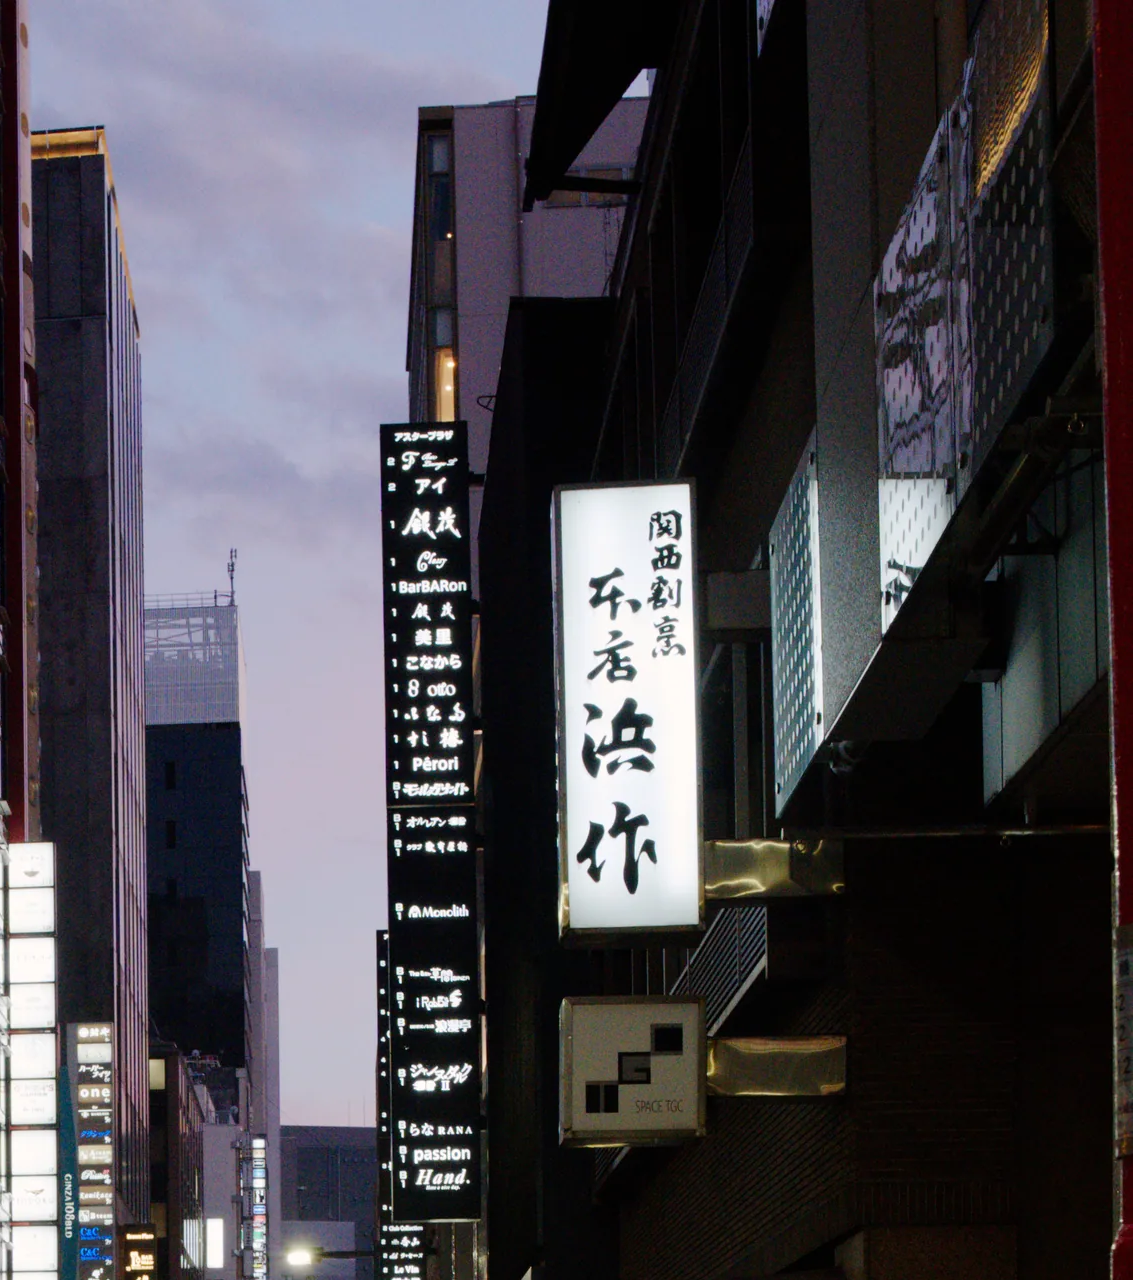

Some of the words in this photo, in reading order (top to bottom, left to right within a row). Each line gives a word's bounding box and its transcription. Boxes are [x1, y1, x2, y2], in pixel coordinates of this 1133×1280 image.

[394, 430, 454, 442] アスタープラザ
[387, 457, 396, 466] 2
[388, 483, 396, 492] 2
[415, 477, 447, 495] アイ
[390, 520, 395, 529] 1
[390, 557, 396, 567] 1
[391, 582, 397, 592] 1
[399, 580, 468, 594] BarBARon
[647, 509, 687, 660] 関西割烹
[391, 607, 397, 617] 1
[392, 633, 397, 642] 1
[415, 628, 452, 646] 美里
[392, 658, 397, 667] 1
[406, 654, 462, 670] こなから
[393, 683, 399, 693] 1
[407, 679, 420, 697] 8
[393, 709, 399, 718] 1
[393, 734, 399, 743] 1
[393, 760, 399, 770] 1
[422, 904, 469, 918] Monolith
[410, 1063, 472, 1084] ジャンヌダルク
[80, 1088, 111, 1098] one
[635, 1100, 664, 1113] SPACE
[666, 1100, 684, 1113] TGC
[410, 1122, 434, 1136] らな
[438, 1125, 472, 1135] RANA
[413, 1146, 471, 1164] passion
[415, 1168, 471, 1186] Hand.
[80, 1227, 99, 1237] C&C
[80, 1247, 100, 1257] C&C
